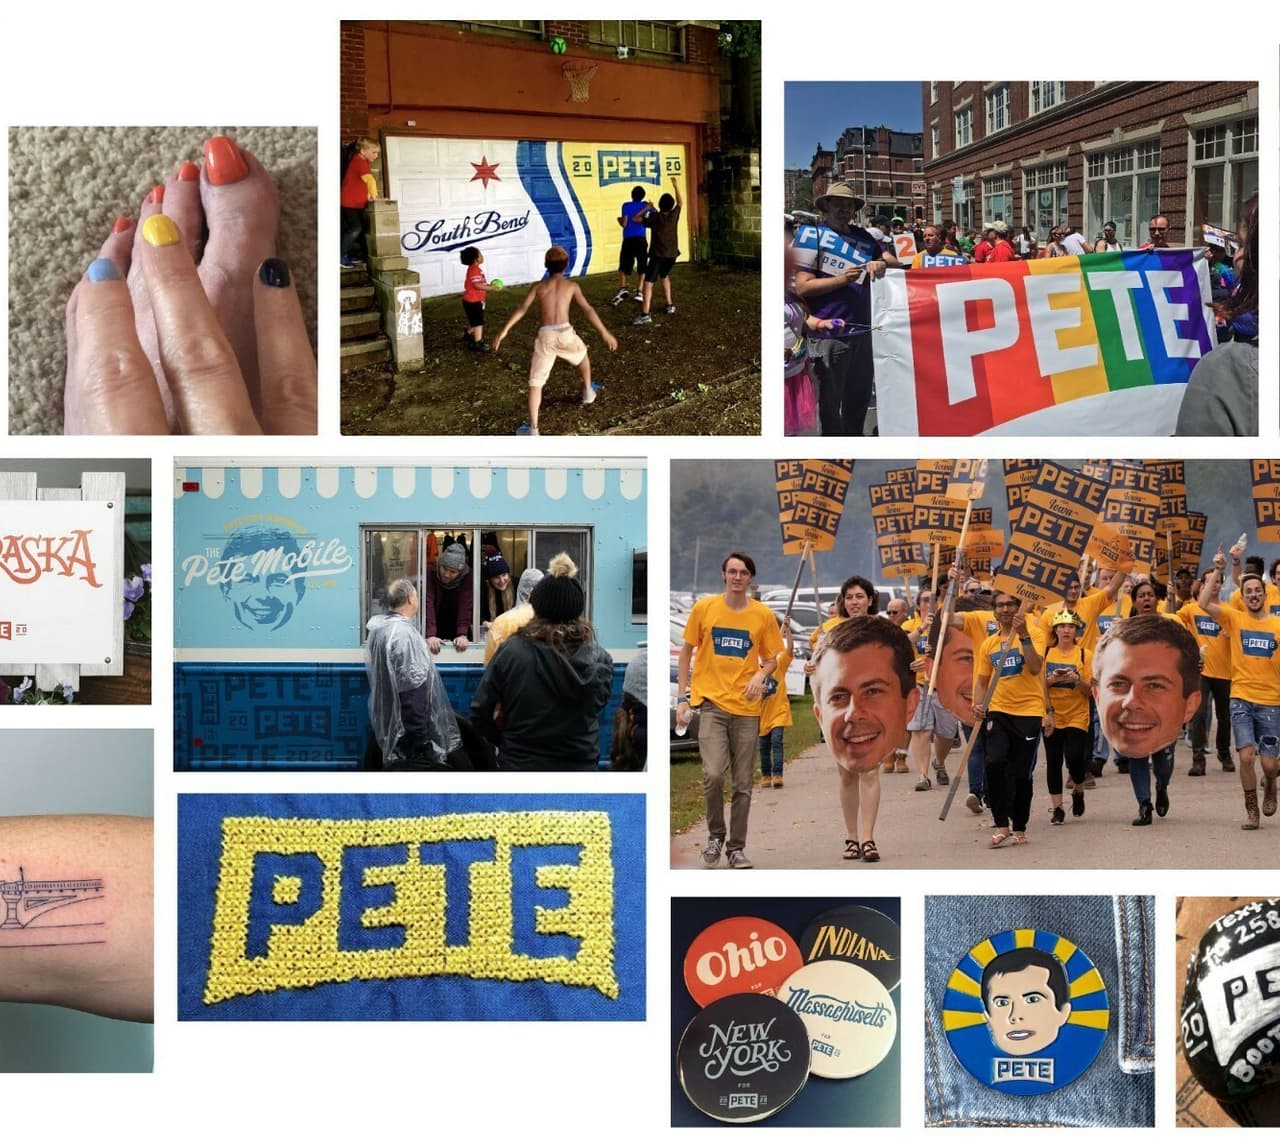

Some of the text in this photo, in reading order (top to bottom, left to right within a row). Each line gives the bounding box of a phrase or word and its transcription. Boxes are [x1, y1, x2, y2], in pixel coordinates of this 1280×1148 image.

[572, 155, 681, 181] 20 PETE 20
[401, 209, 531, 252] South Bend
[798, 226, 873, 264] PETE
[895, 236, 917, 258] 2
[935, 269, 1203, 407] PETE
[803, 472, 847, 500] PETE
[870, 484, 912, 503] PETE
[1037, 463, 1107, 506] PETE
[1111, 469, 1161, 491] PETE
[794, 503, 839, 531] PETE
[914, 508, 965, 529] PETE
[1020, 506, 1089, 549] PETE
[1106, 503, 1157, 525] PETE
[181, 537, 353, 587] Pete Mobile
[205, 547, 220, 558] THE
[881, 544, 923, 564] PETE
[1032, 541, 1057, 560] Iowa
[1004, 548, 1072, 591] PETE
[1016, 583, 1041, 601] Iowa
[722, 638, 743, 649] PETE
[1248, 638, 1269, 649] PETE
[258, 709, 326, 737] PETE
[244, 838, 585, 962] PETE
[808, 924, 897, 961] INDIANA
[696, 931, 787, 986] Ohio
[788, 986, 892, 1029] Massachusetts
[699, 1016, 777, 1058] NEW
[1182, 1012, 1206, 1050] 20
[704, 1039, 792, 1080] YORK
[812, 1041, 834, 1056] PETE
[998, 1061, 1051, 1078] PETE
[730, 1095, 757, 1107] PETE
